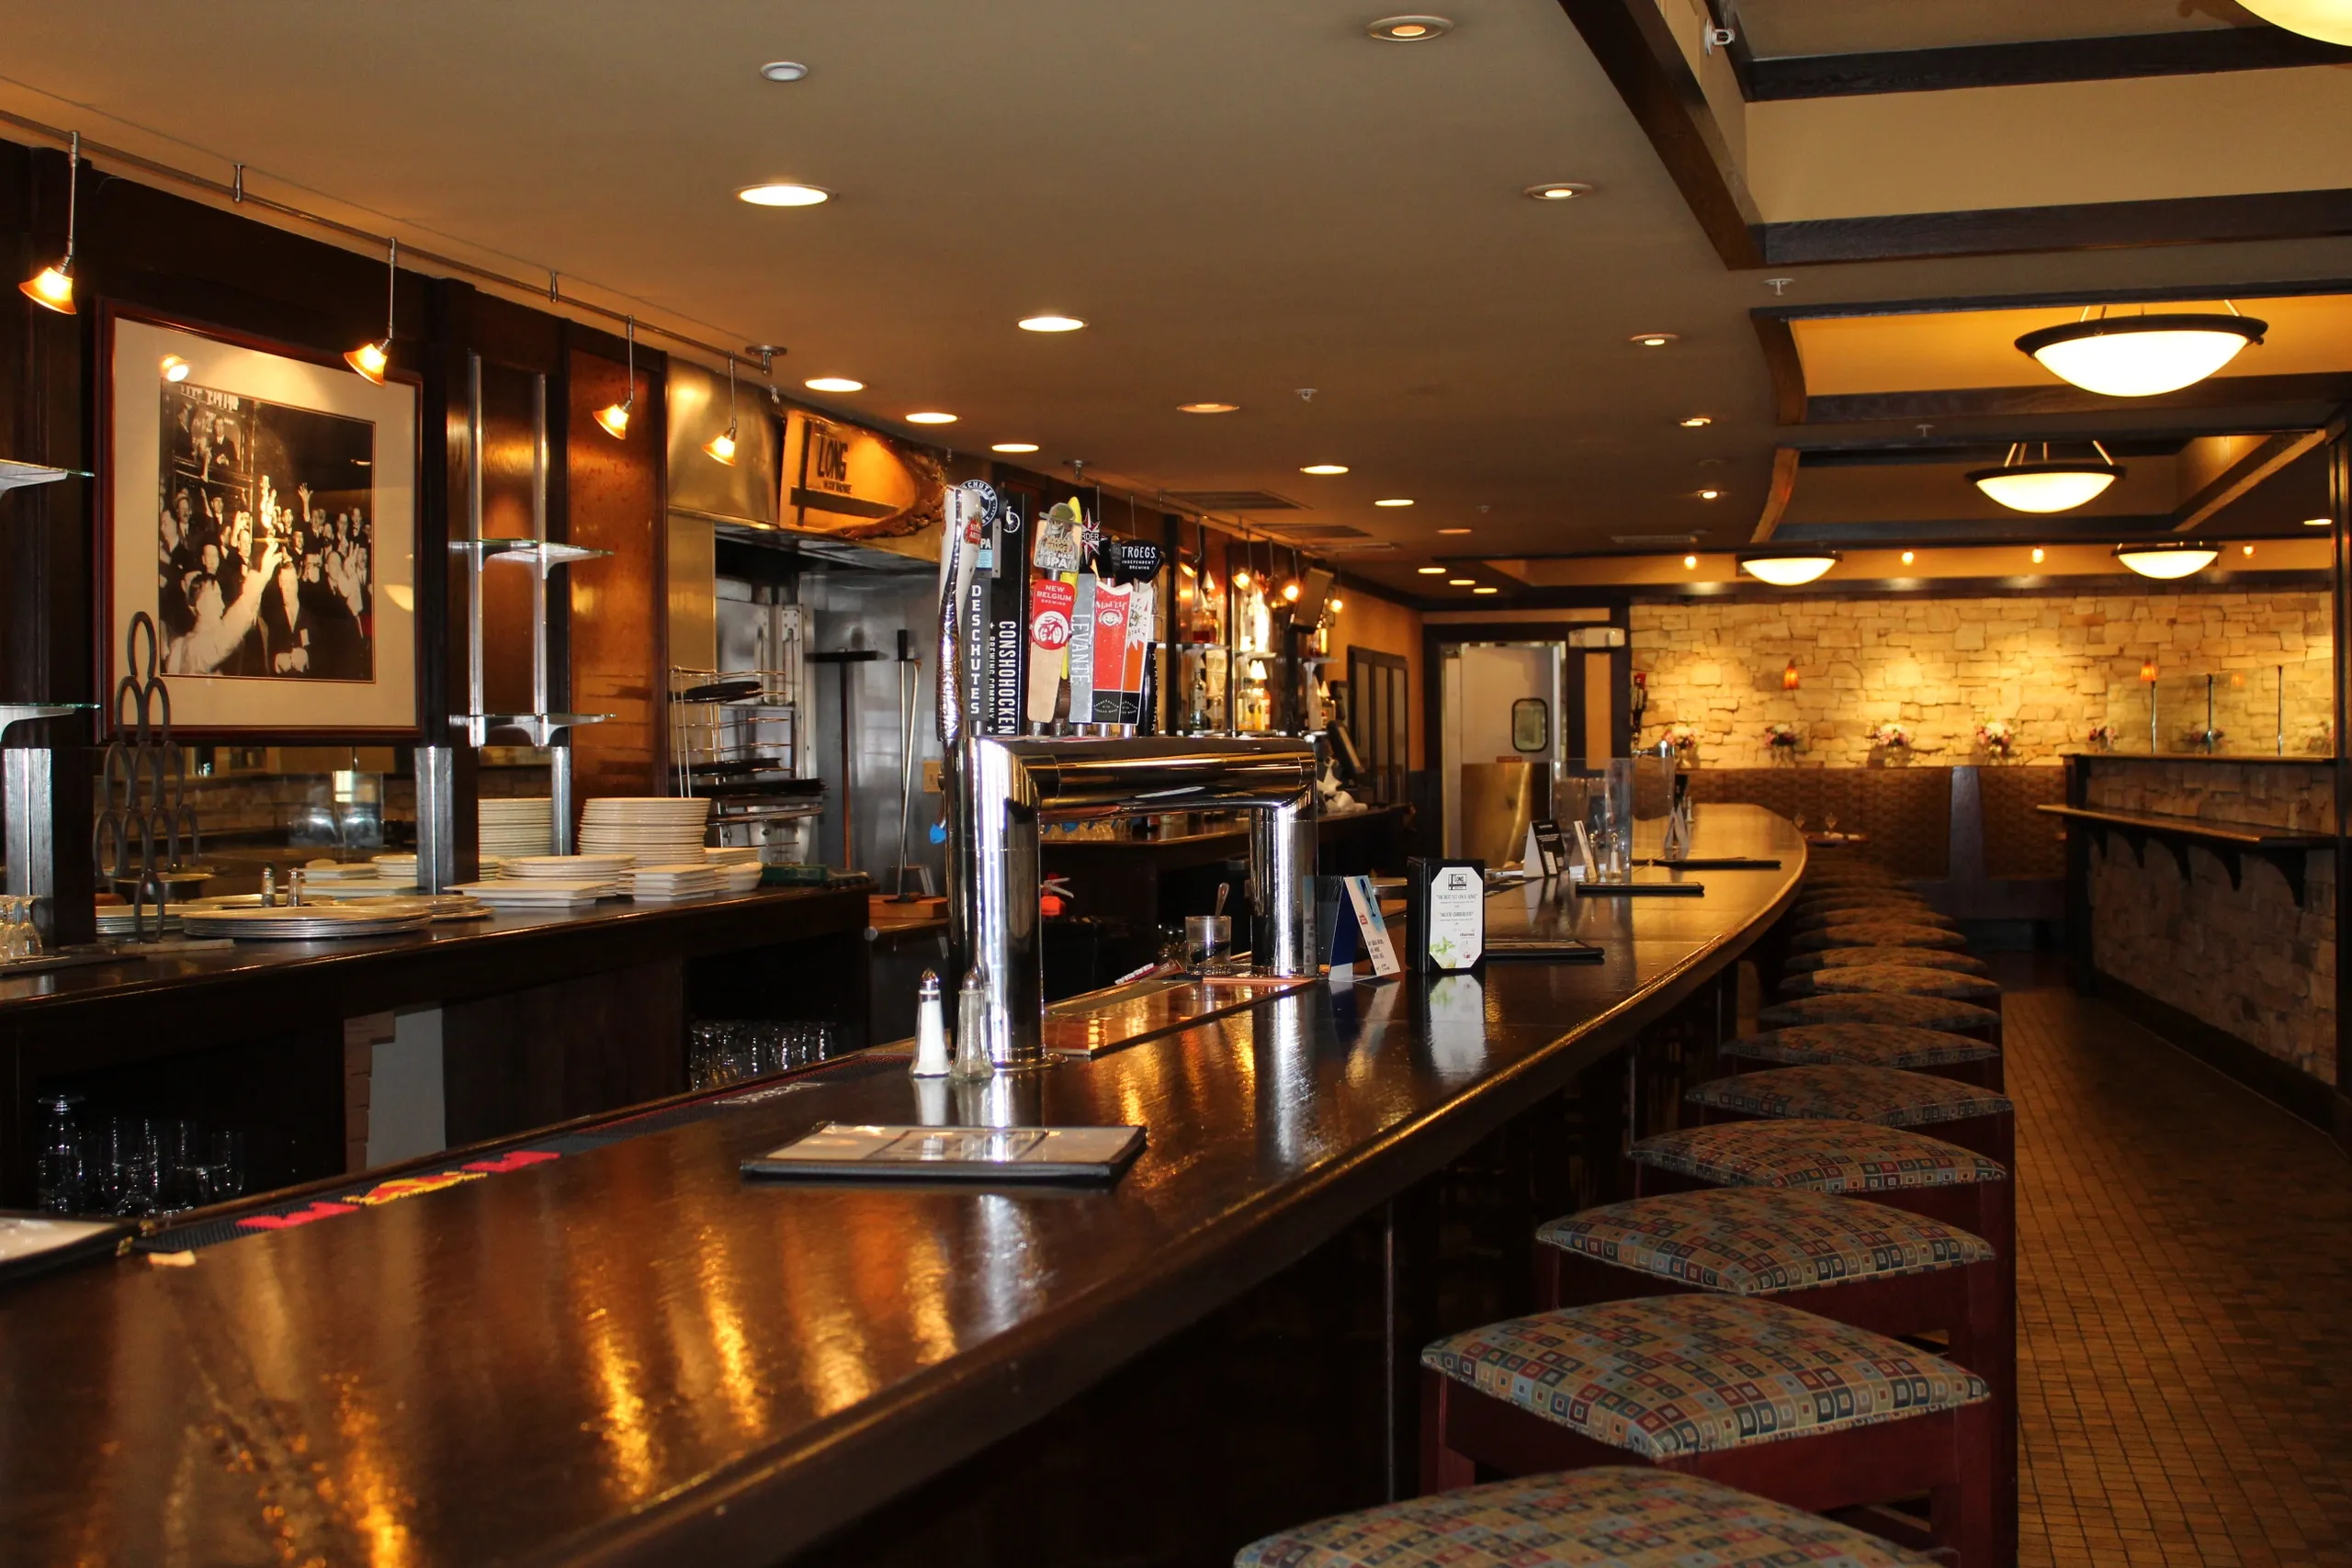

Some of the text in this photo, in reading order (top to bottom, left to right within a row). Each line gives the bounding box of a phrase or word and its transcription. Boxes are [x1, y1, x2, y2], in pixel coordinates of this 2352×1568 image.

[979, 537, 992, 549] PA
[1046, 556, 1069, 569] IPA
[1045, 584, 1066, 593] NEW
[1035, 591, 1073, 603] BELGIUM
[1040, 598, 1067, 606] BREWING
[970, 584, 982, 715] DESCHUTES
[1070, 613, 1091, 684] LEVANTE
[998, 620, 1017, 735] CONSHOHOCKEN
